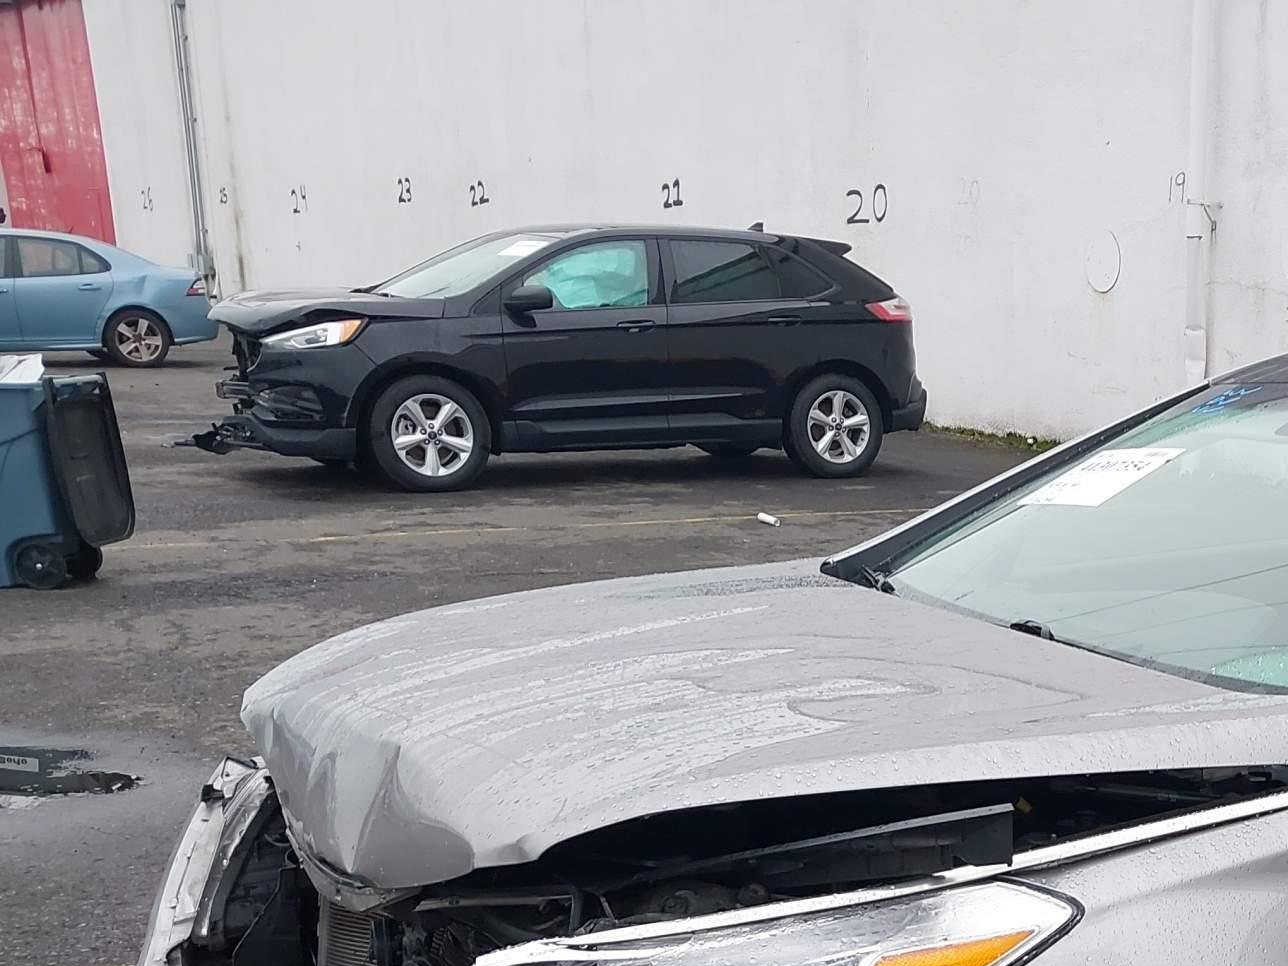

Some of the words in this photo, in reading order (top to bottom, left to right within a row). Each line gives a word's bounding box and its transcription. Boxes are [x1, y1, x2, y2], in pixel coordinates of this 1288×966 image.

[290, 183, 309, 214] 24
[397, 177, 412, 204] 23
[468, 180, 491, 207] 22
[660, 178, 684, 209] 21
[1168, 171, 1187, 204] 19
[845, 183, 889, 225] 20
